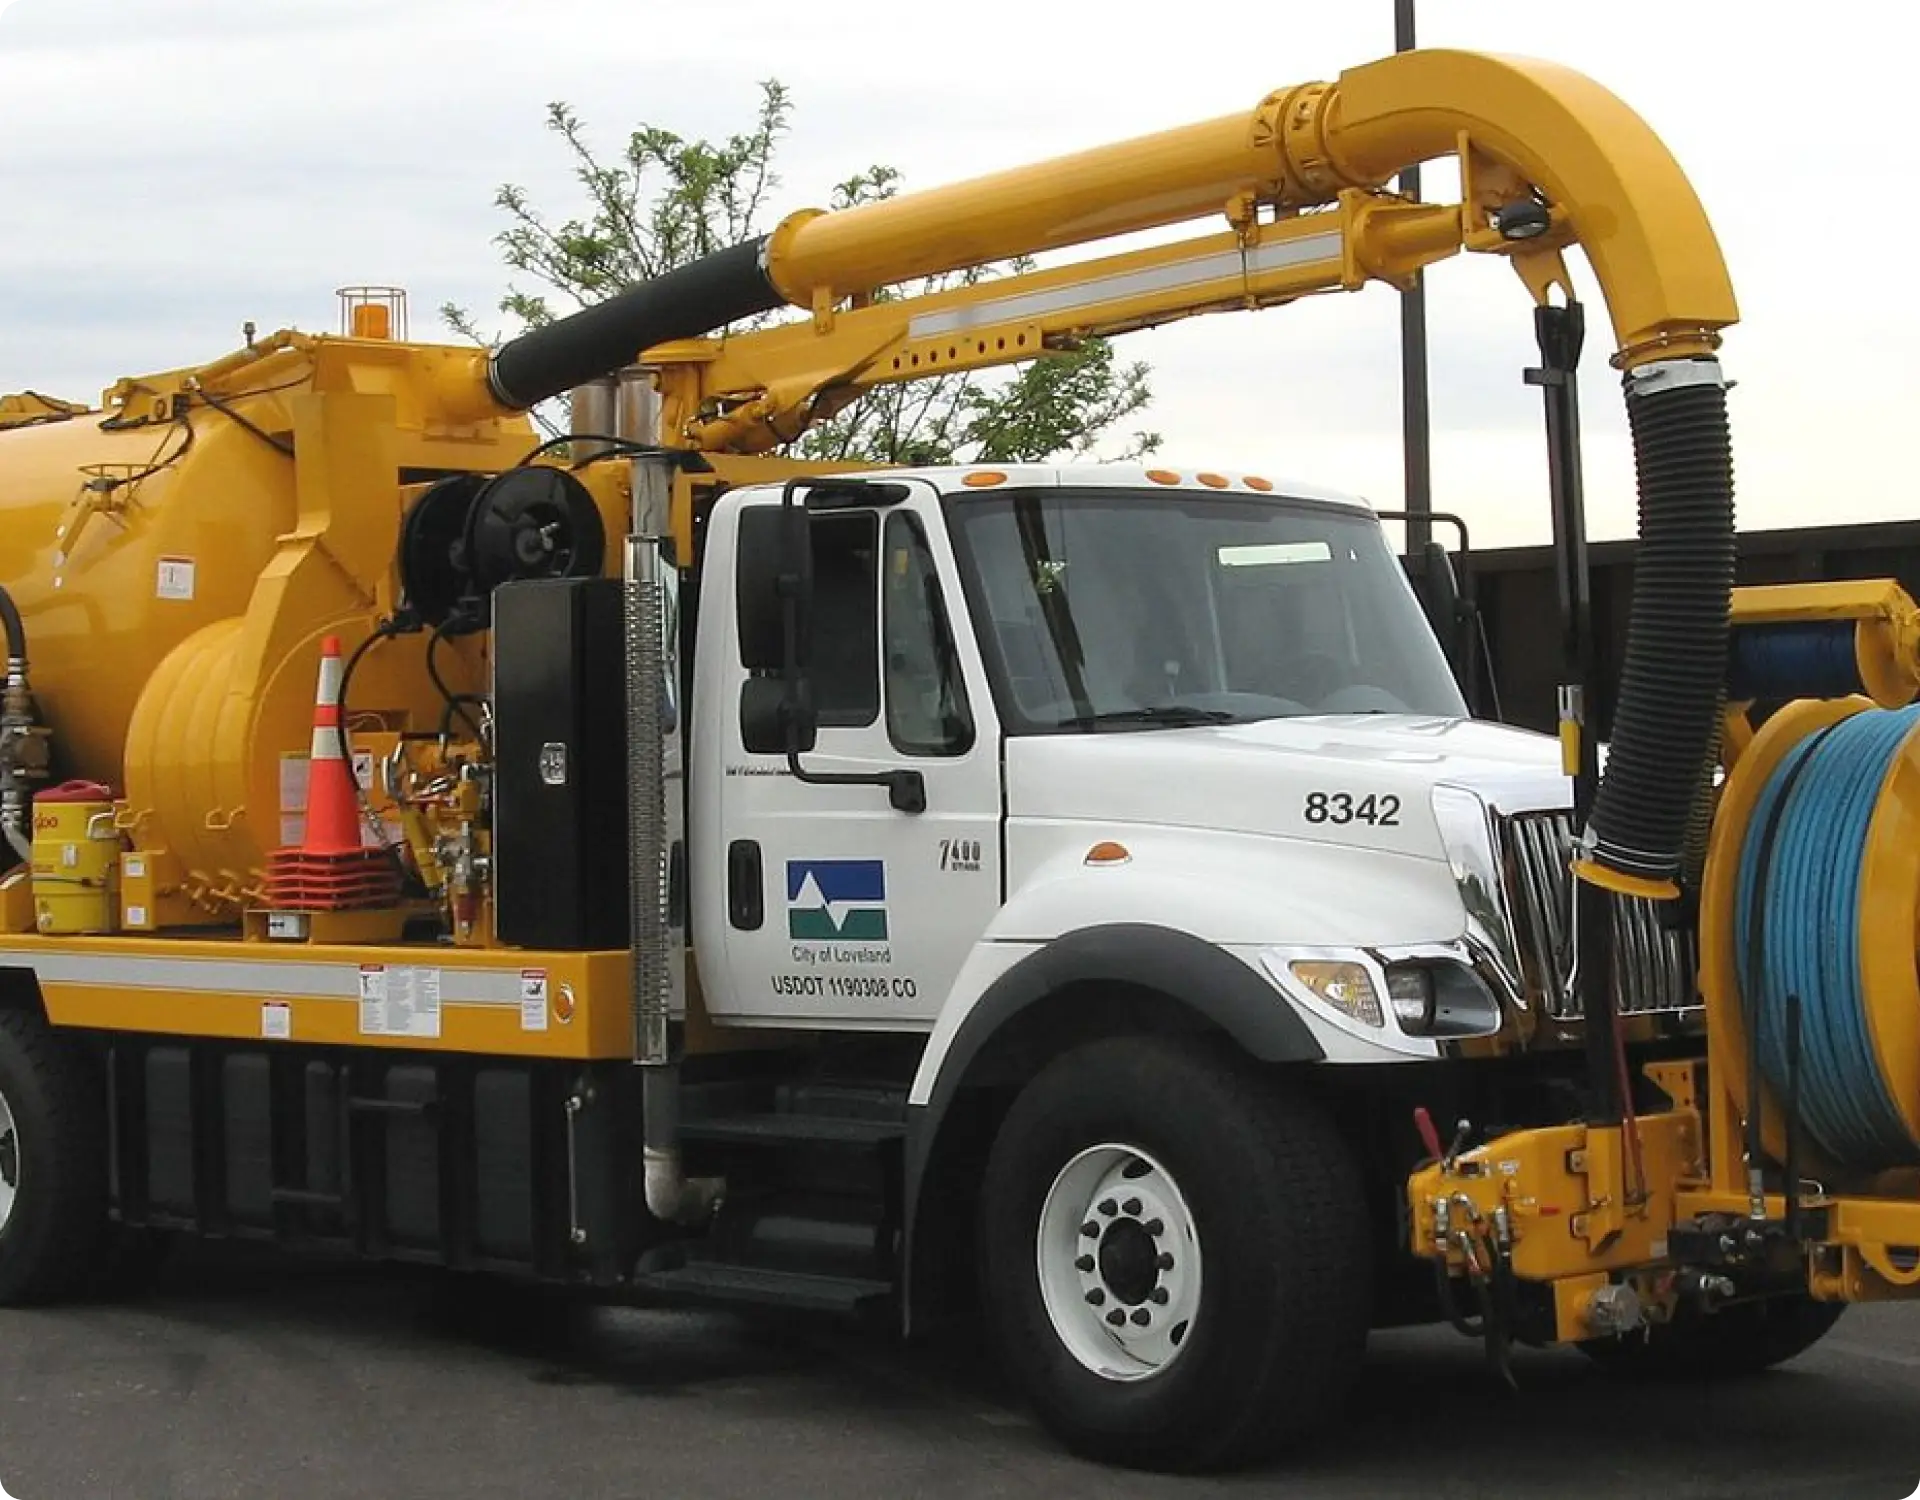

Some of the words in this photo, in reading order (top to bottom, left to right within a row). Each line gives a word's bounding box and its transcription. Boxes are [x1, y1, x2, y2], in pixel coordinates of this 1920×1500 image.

[1304, 791, 1400, 826] 8342
[940, 839, 981, 870] 7400
[791, 945, 816, 966] City
[819, 946, 832, 963] of
[834, 946, 892, 964] Loveland
[771, 975, 824, 996] USDOT
[829, 977, 889, 998] 1190308
[892, 977, 917, 998] CO
